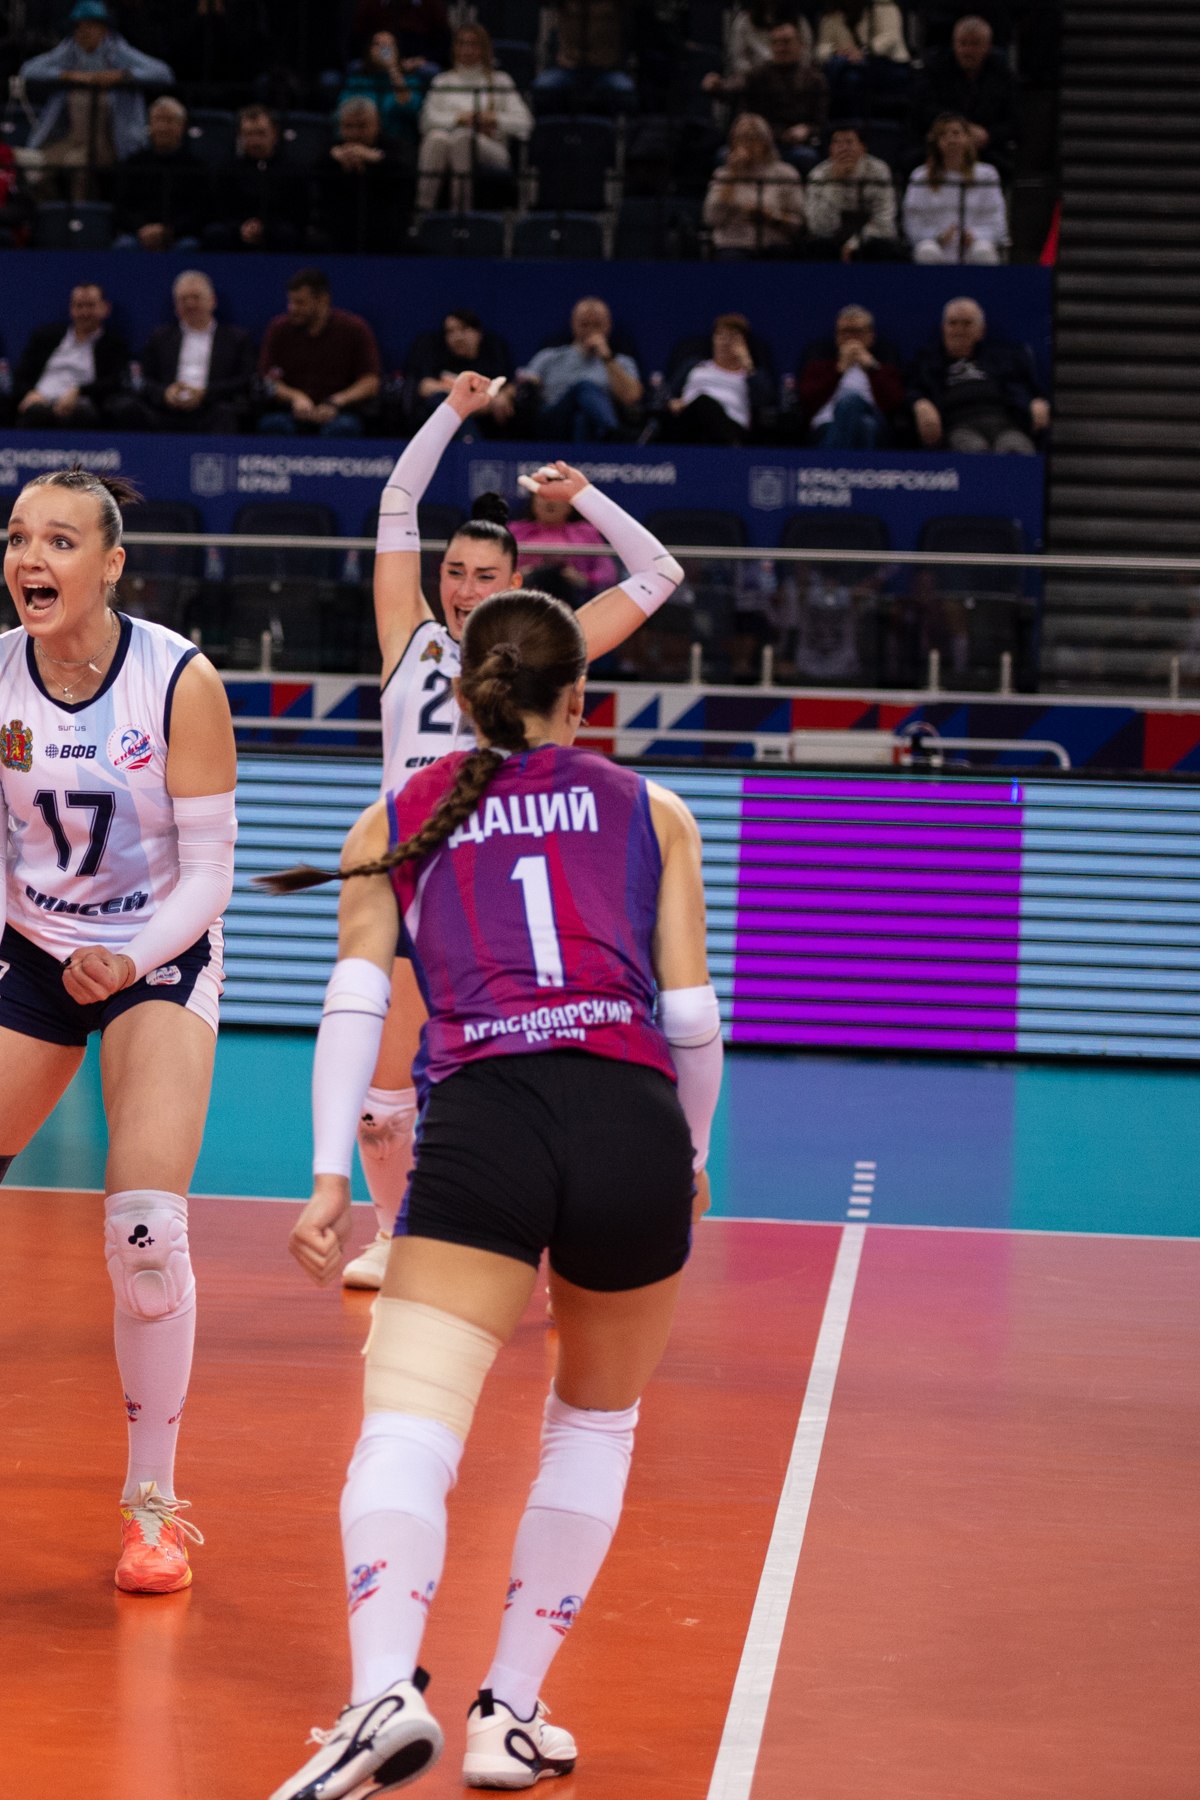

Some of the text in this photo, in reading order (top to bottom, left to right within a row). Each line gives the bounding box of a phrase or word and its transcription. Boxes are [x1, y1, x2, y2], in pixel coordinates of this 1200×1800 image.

[798, 467, 959, 491] КРАСНОЯРСКИЙ
[60, 744, 98, 759] ВФВ
[33, 789, 117, 877] 17
[25, 885, 149, 917] ЕНИСЕЙ
[510, 854, 565, 988] 1
